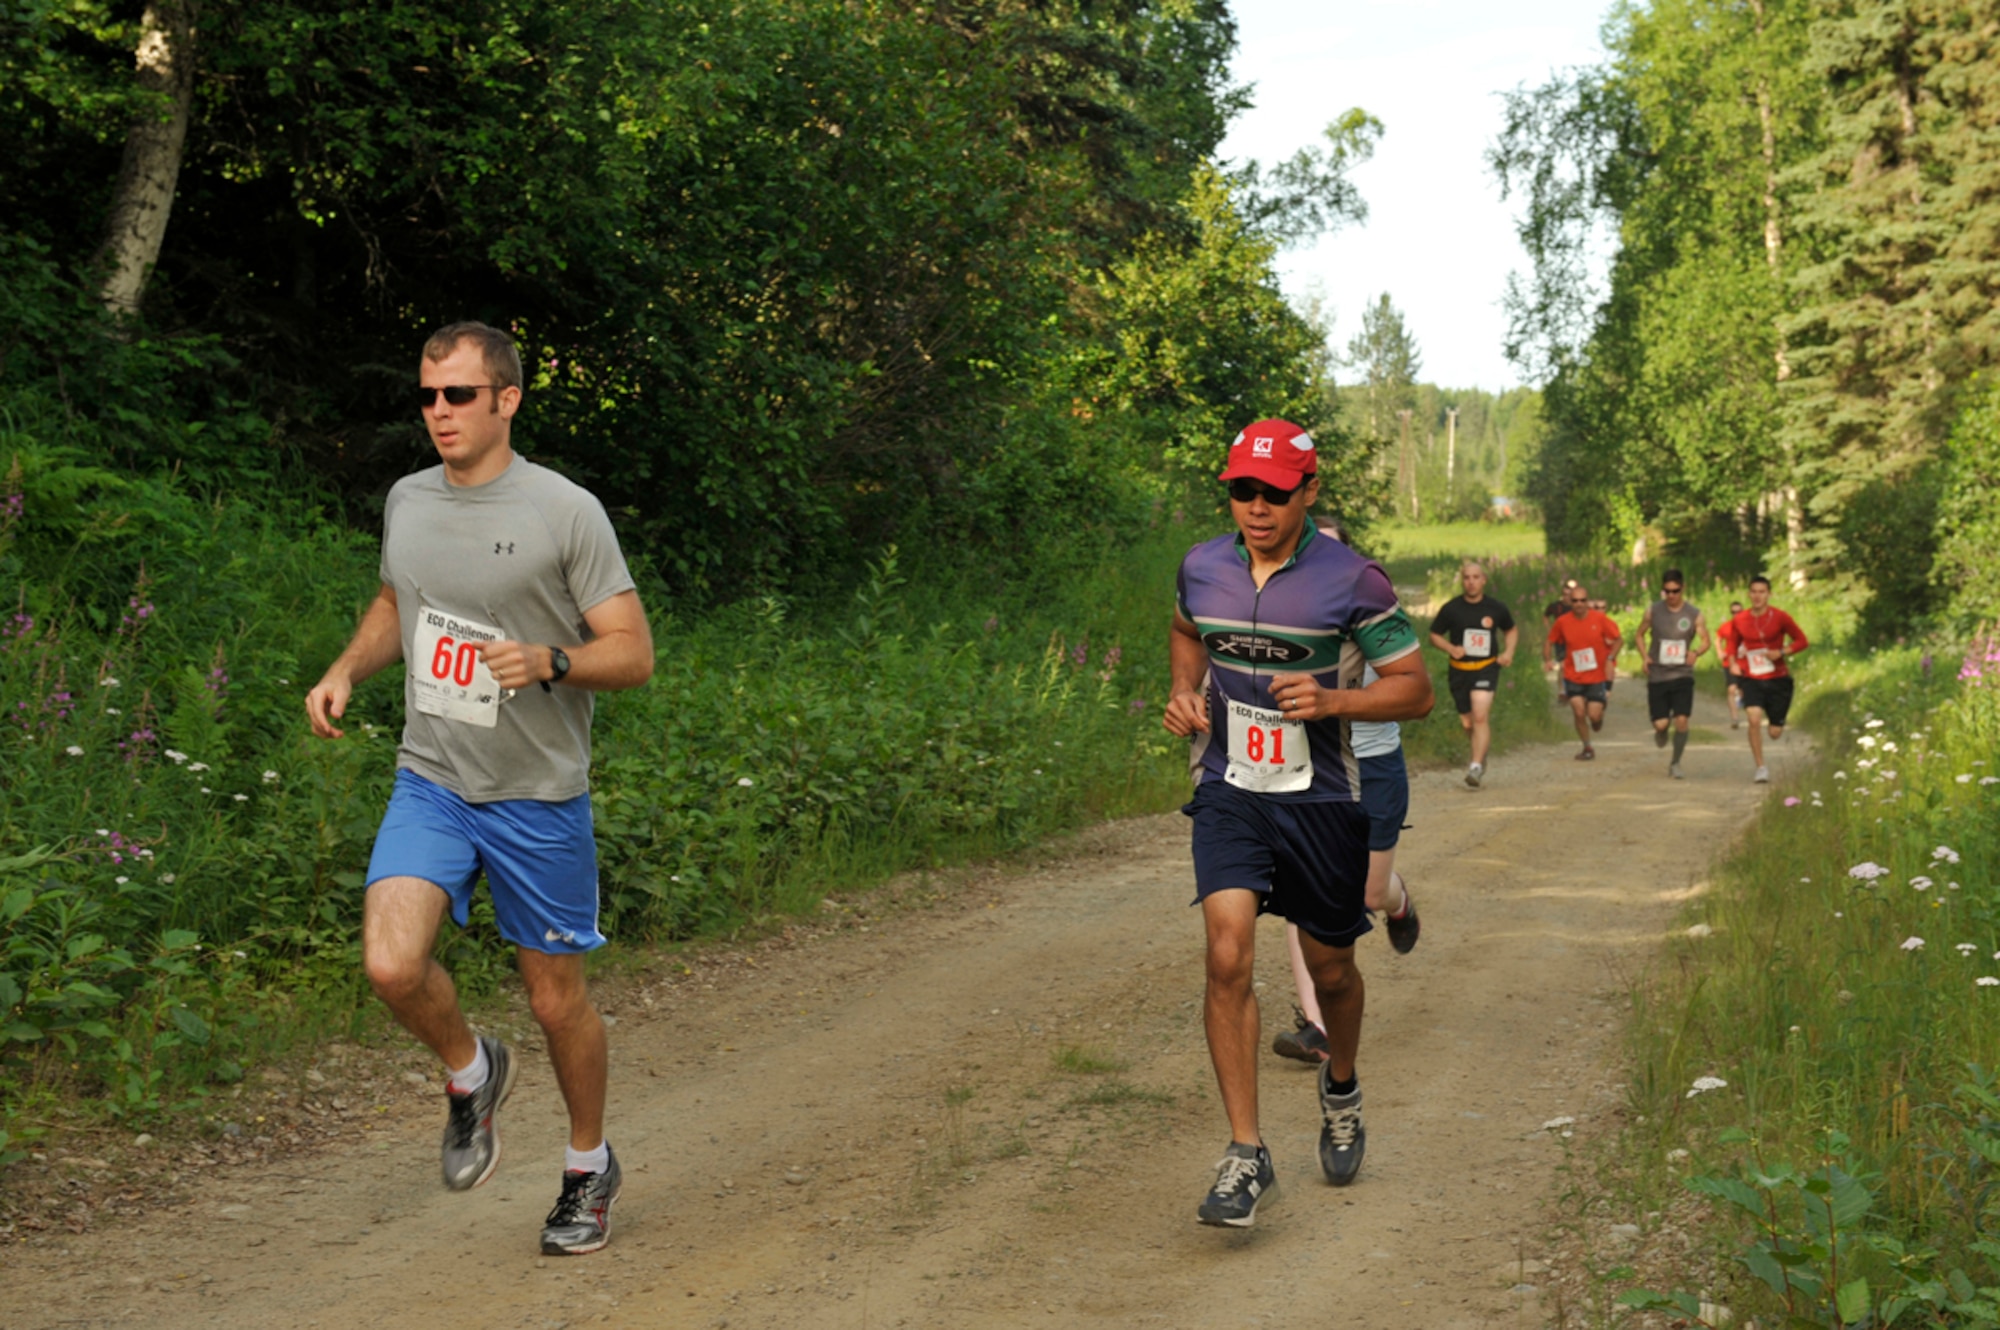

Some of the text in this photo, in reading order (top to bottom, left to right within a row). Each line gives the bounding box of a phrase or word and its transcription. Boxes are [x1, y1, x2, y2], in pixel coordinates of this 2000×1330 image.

[427, 613, 446, 628] ECO
[1217, 639, 1290, 660] XTR
[431, 636, 476, 687] 60
[1236, 705, 1252, 719] ECO
[1247, 724, 1286, 765] 81
